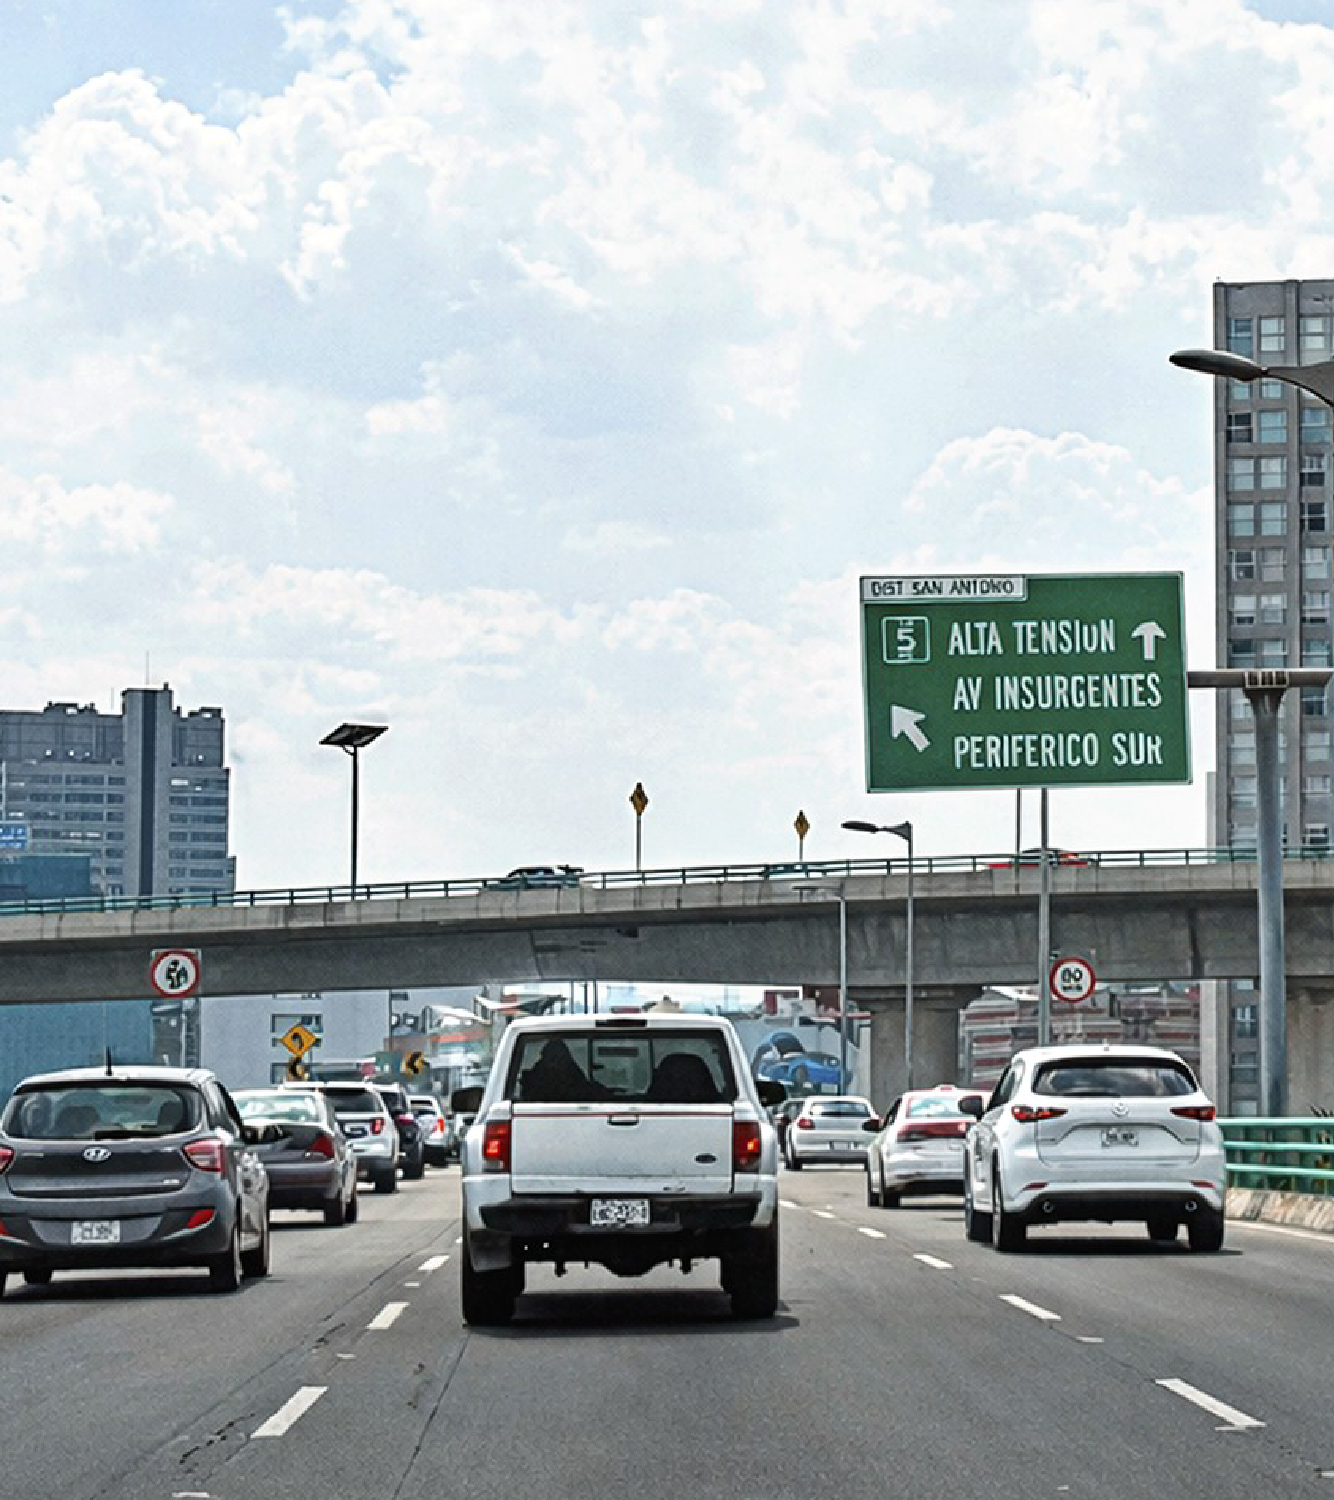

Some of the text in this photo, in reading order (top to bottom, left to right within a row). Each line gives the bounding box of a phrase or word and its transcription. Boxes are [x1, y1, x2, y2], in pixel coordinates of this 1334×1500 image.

[913, 580, 942, 595] SAN
[896, 627, 917, 651] 5
[948, 621, 1004, 656] ALTA
[954, 673, 1163, 711] AV INSURGENTES
[954, 732, 1164, 769] PERIFERICO SUR
